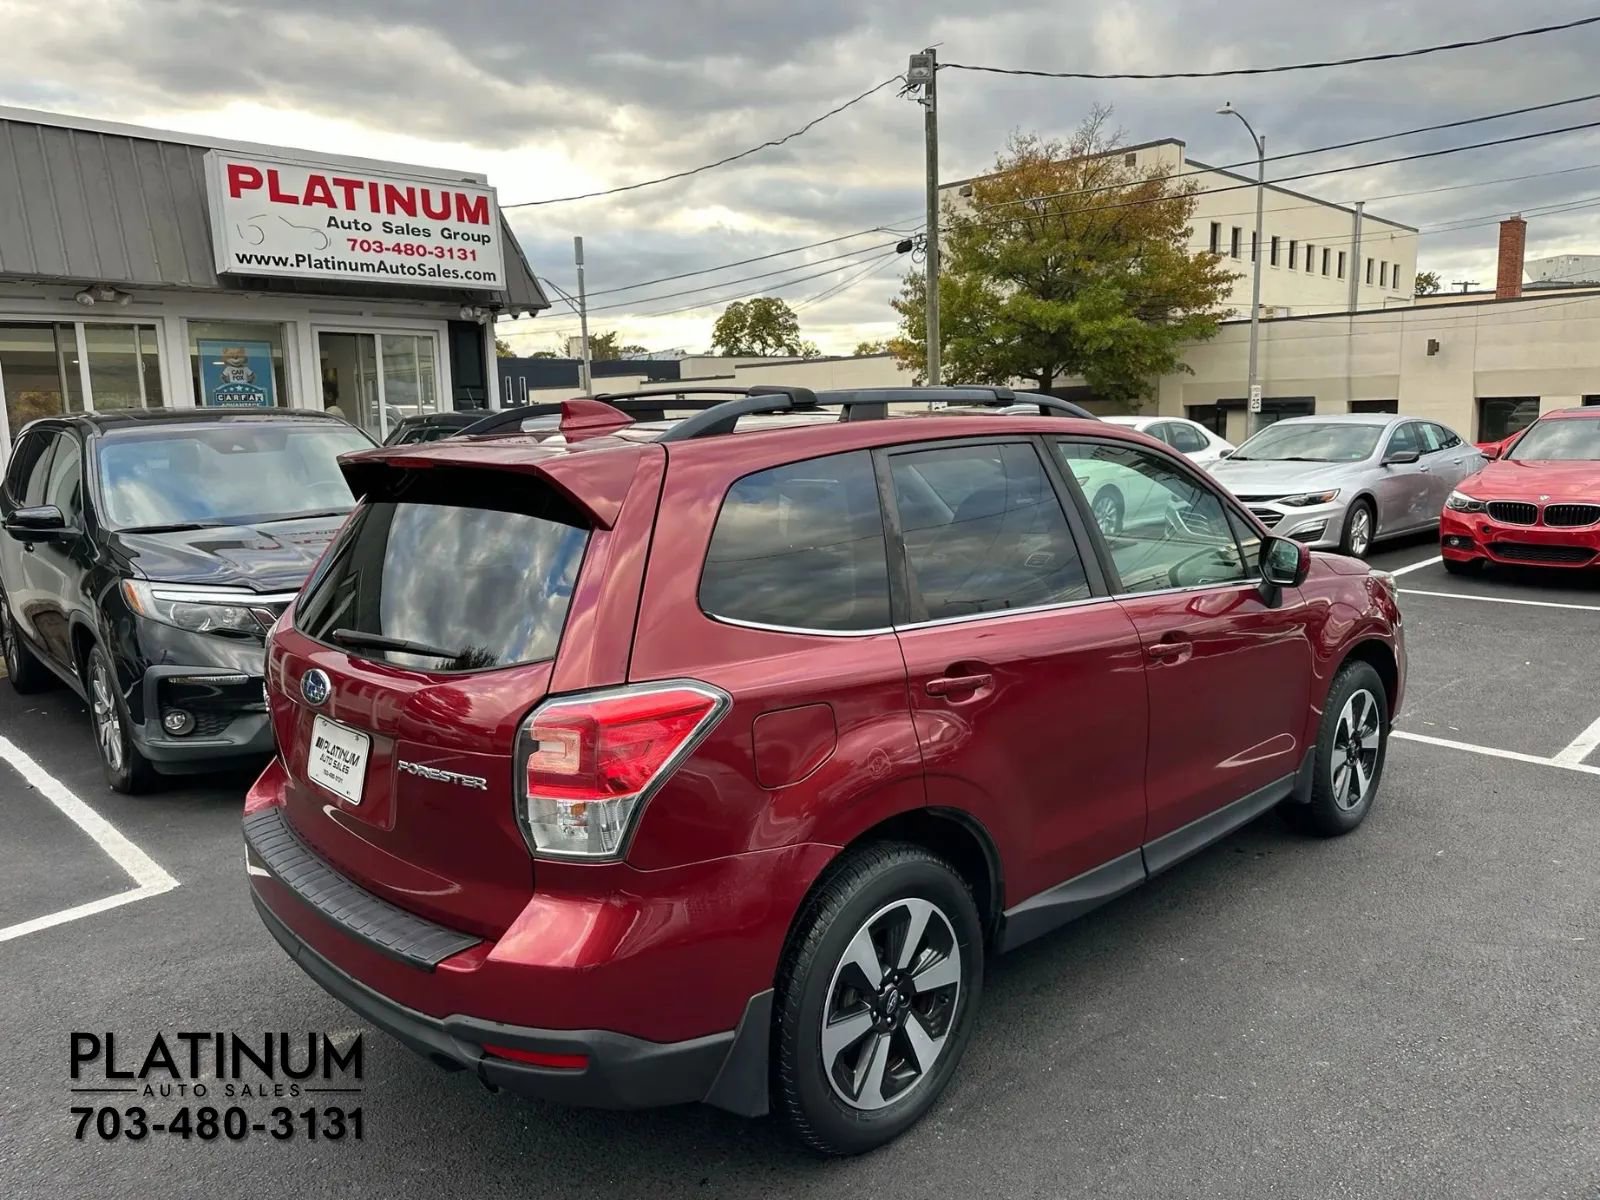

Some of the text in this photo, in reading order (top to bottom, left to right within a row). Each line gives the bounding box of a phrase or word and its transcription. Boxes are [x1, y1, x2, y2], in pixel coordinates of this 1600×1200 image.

[227, 164, 490, 225] PLATINUM
[326, 215, 491, 245] Auto Sales Group
[347, 238, 477, 261] 703-480-3131
[235, 252, 497, 282] www.PlatinumAutoSales.com
[217, 394, 264, 402] CARFAX
[319, 753, 350, 775] AUTO SALES
[323, 740, 361, 767] PLATINUM
[398, 760, 488, 790] FORESTER
